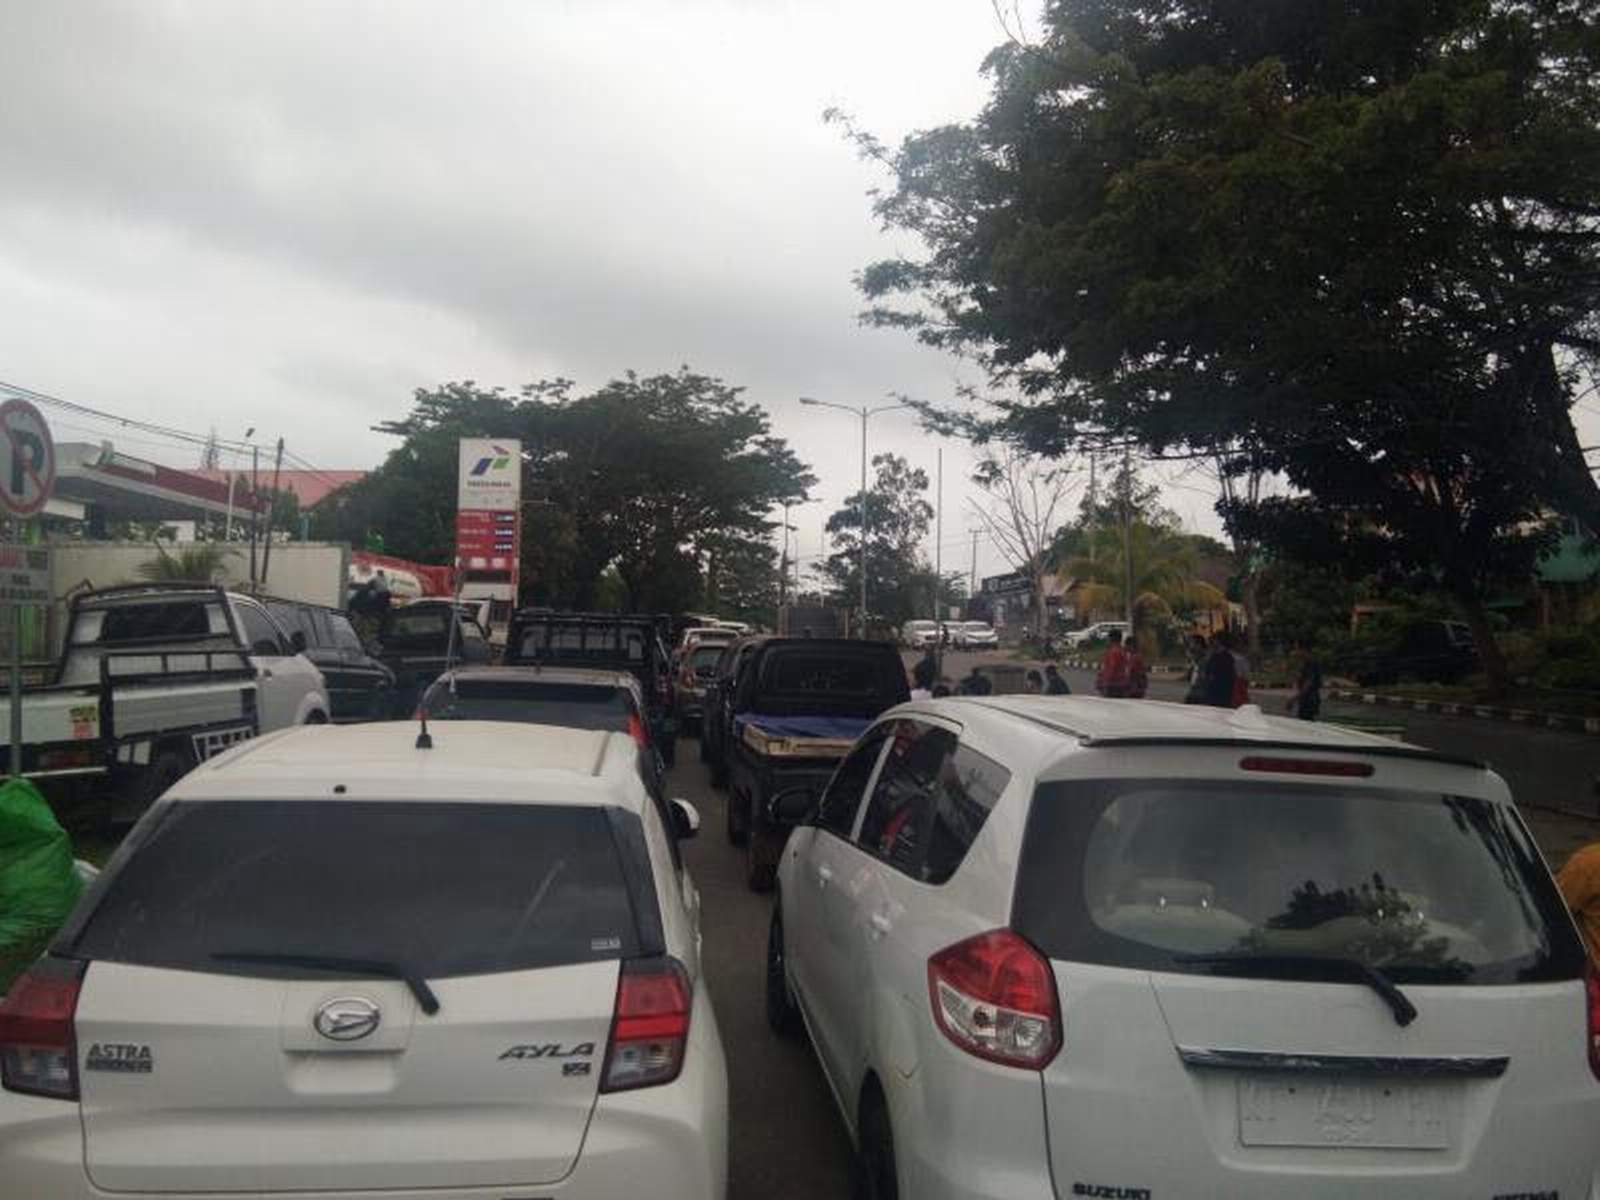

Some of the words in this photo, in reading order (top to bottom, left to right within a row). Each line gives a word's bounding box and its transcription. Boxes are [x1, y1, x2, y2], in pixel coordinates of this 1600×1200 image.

[86, 1043, 151, 1058] ASTRA
[499, 1042, 594, 1060] AYLA
[1073, 1182, 1151, 1200] SUZUKI
